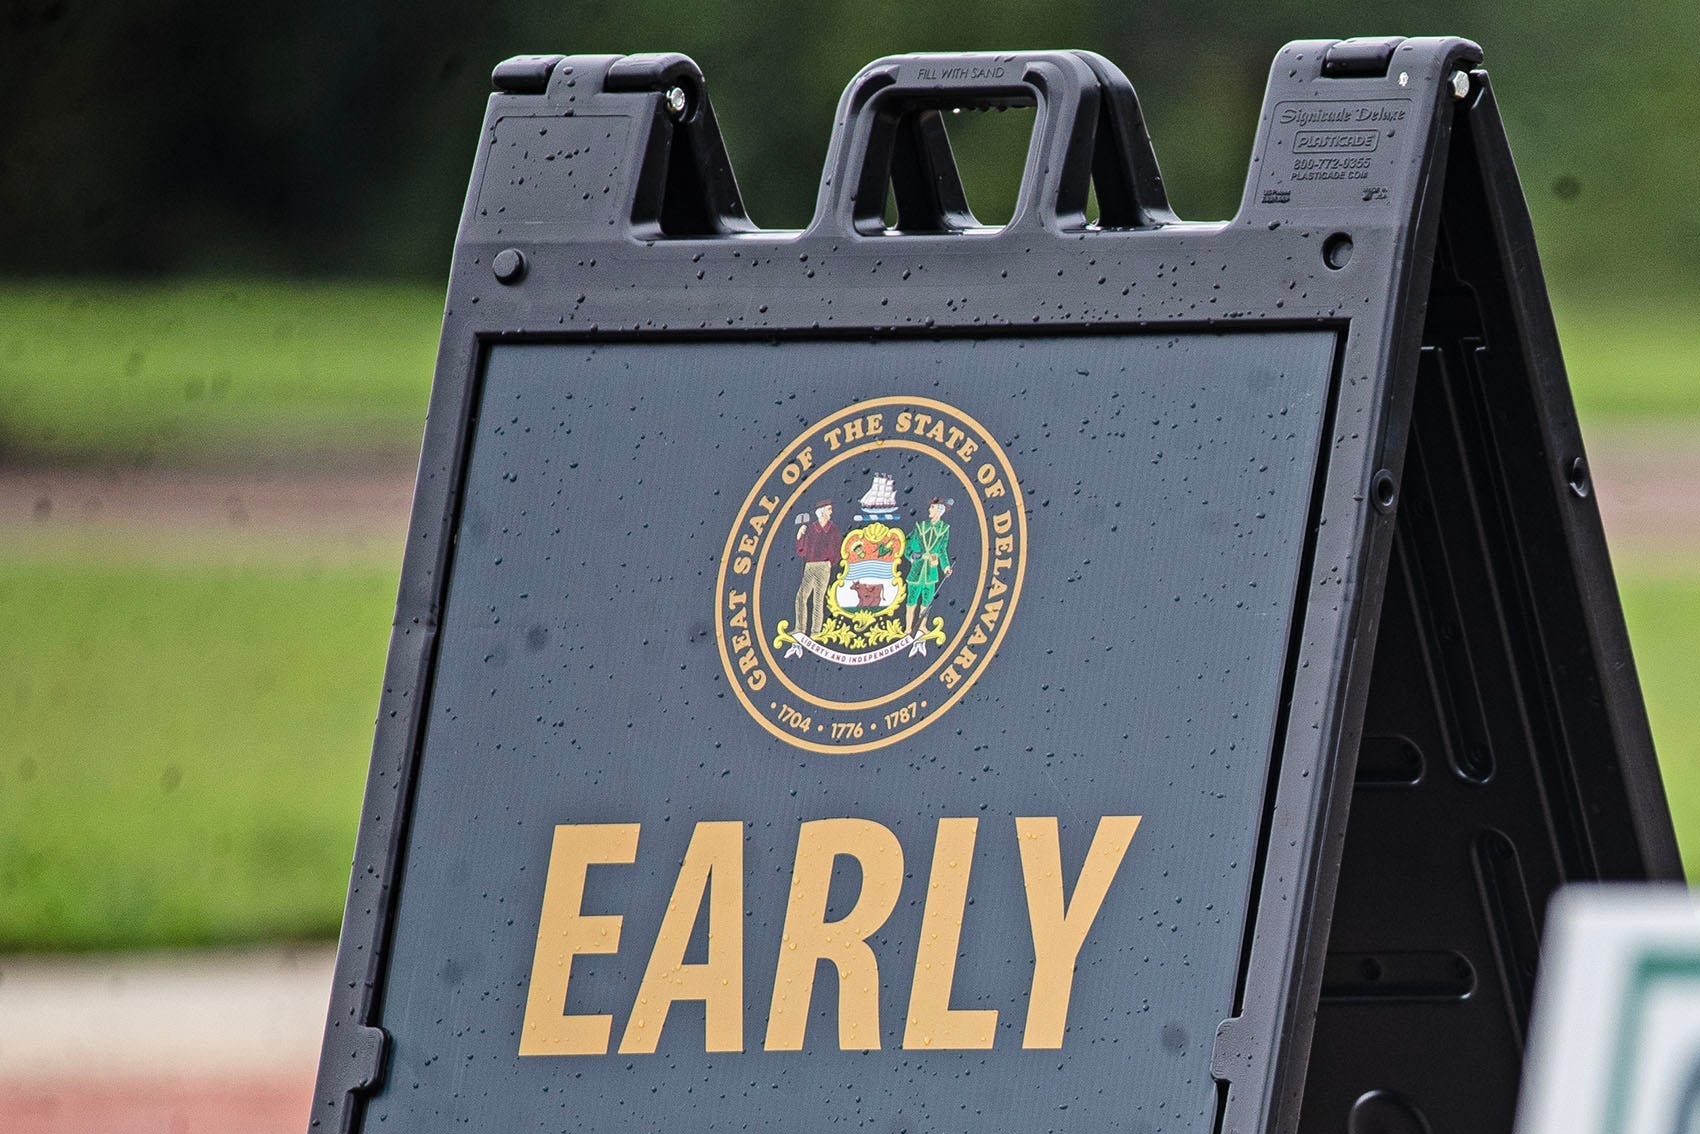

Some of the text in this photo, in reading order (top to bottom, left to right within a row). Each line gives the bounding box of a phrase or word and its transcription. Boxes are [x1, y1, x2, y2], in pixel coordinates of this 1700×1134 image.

[917, 66, 1005, 80] FILL WITH SAND
[1279, 107, 1406, 127] Signicade Deluxe
[1297, 134, 1376, 148] PLASTICADE
[728, 411, 1014, 691] GREAT SEAL OF THE STATE OF DELAWARE
[800, 636, 911, 663] LIBERTY AND INDEPENDENCE
[777, 701, 918, 739] 1704 1776 1787
[518, 815, 1142, 1056] EARLY
